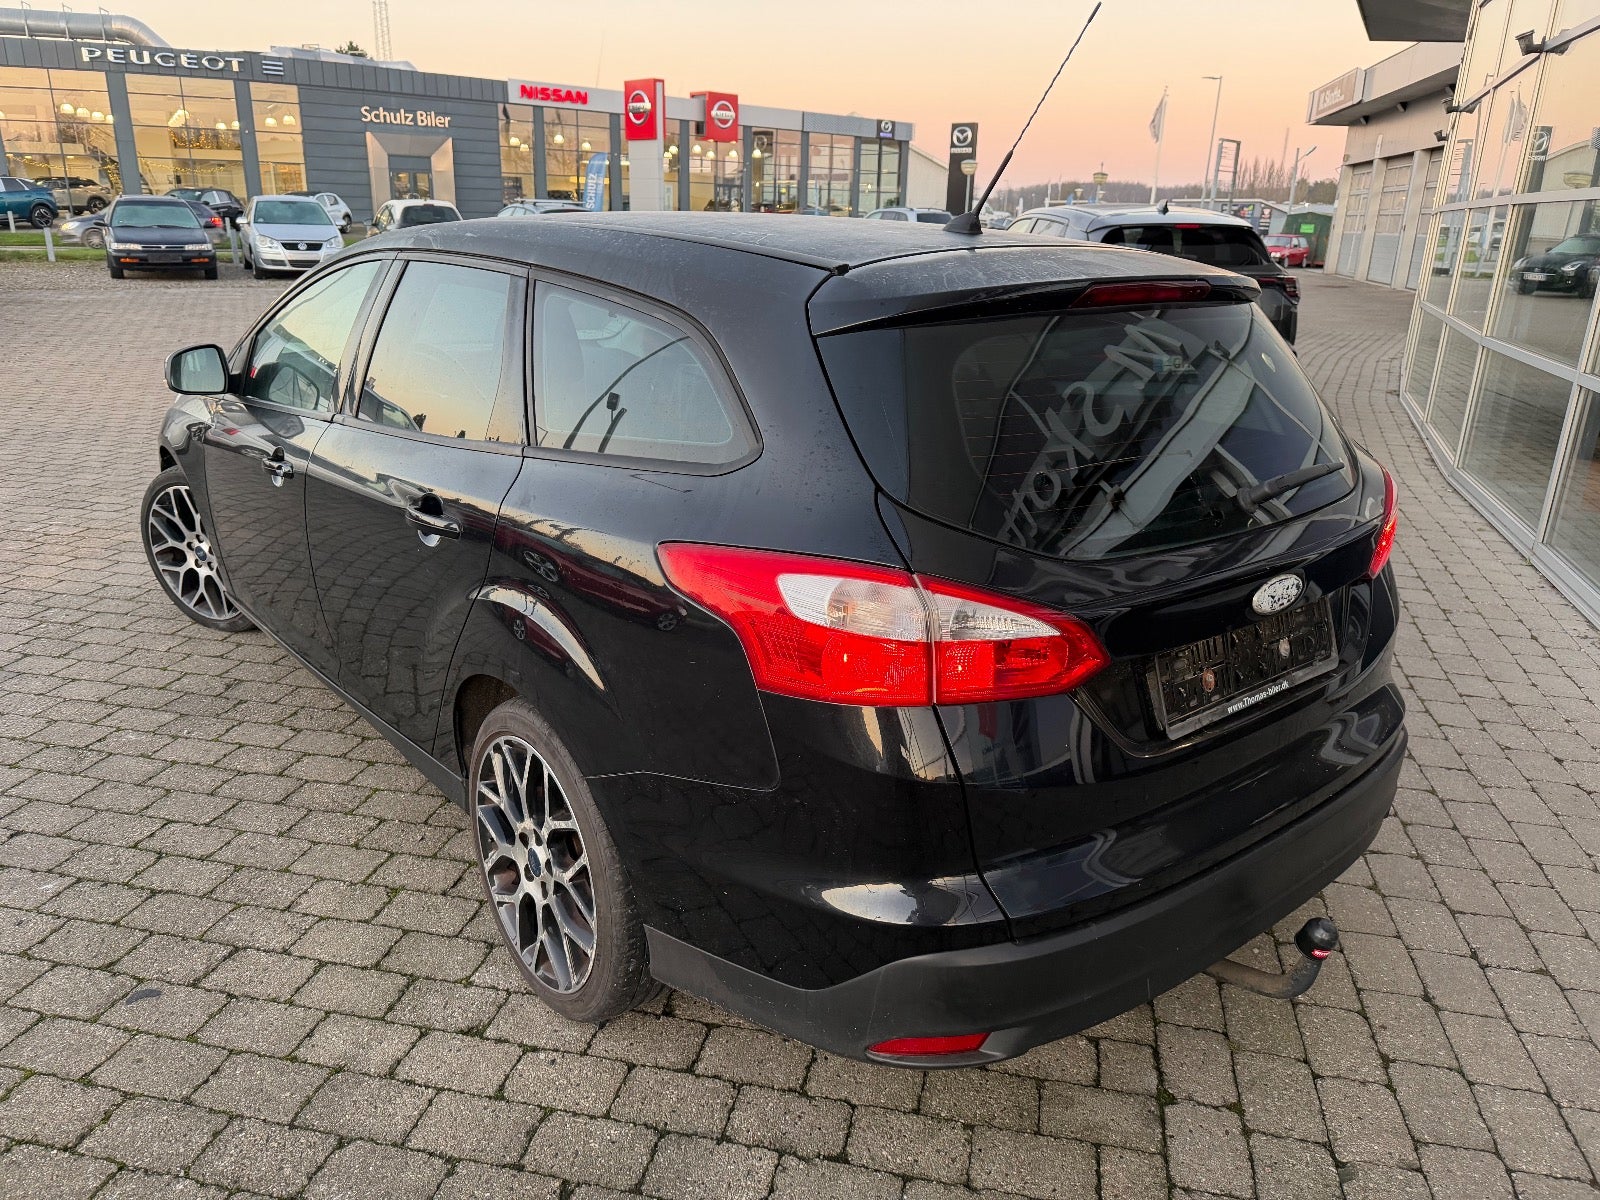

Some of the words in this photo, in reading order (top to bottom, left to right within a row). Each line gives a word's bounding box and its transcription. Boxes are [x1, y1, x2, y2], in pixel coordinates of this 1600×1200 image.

[80, 46, 245, 73] PEUGEOT
[519, 84, 588, 106] NISSAN
[360, 105, 415, 126] Schulz
[416, 110, 451, 129] Biler
[585, 172, 598, 210] SCHULZ
